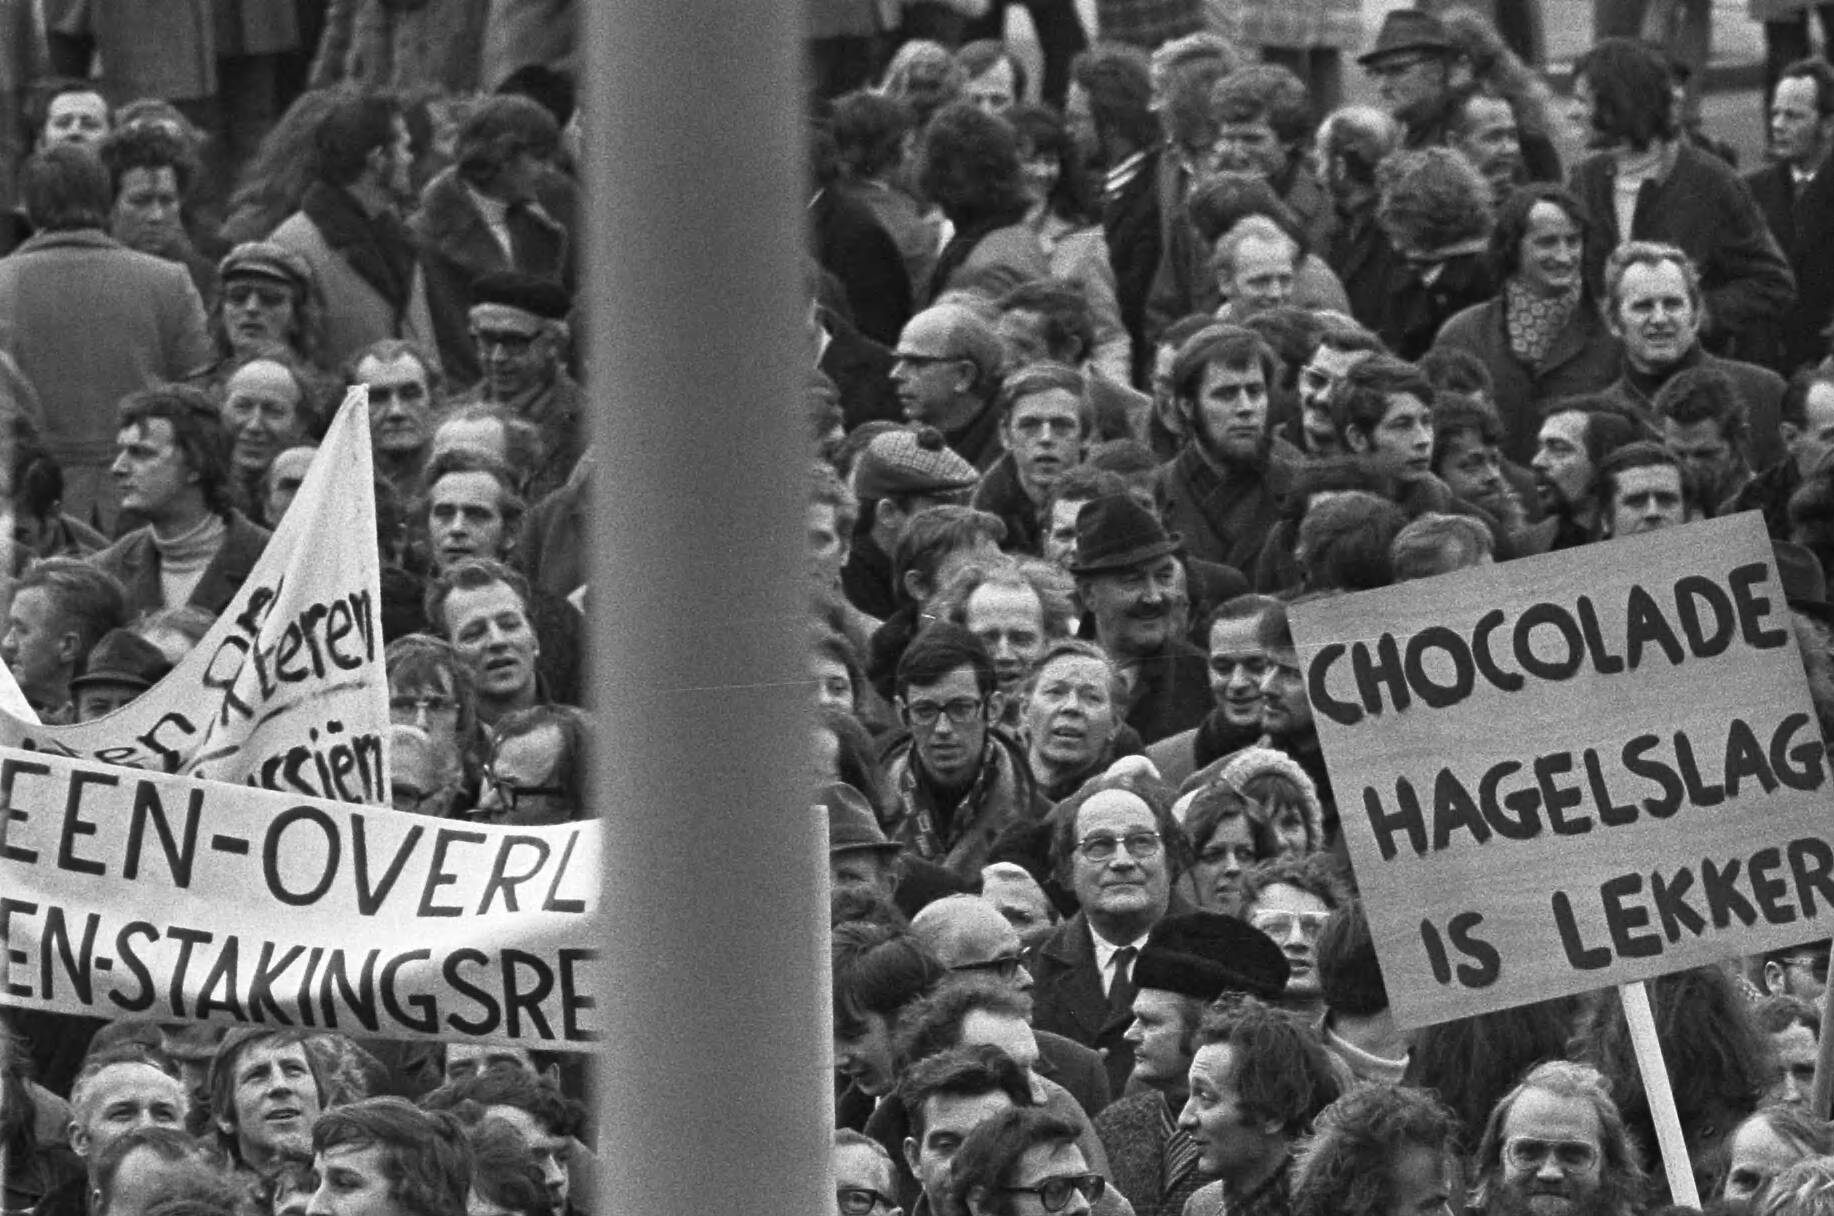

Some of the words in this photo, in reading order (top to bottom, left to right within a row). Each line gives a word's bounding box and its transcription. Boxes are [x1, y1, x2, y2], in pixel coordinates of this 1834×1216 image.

[1308, 562, 1788, 725] CHOCOLADE
[1363, 713, 1825, 861] HAGELSLAG
[1420, 911, 1501, 989] IS
